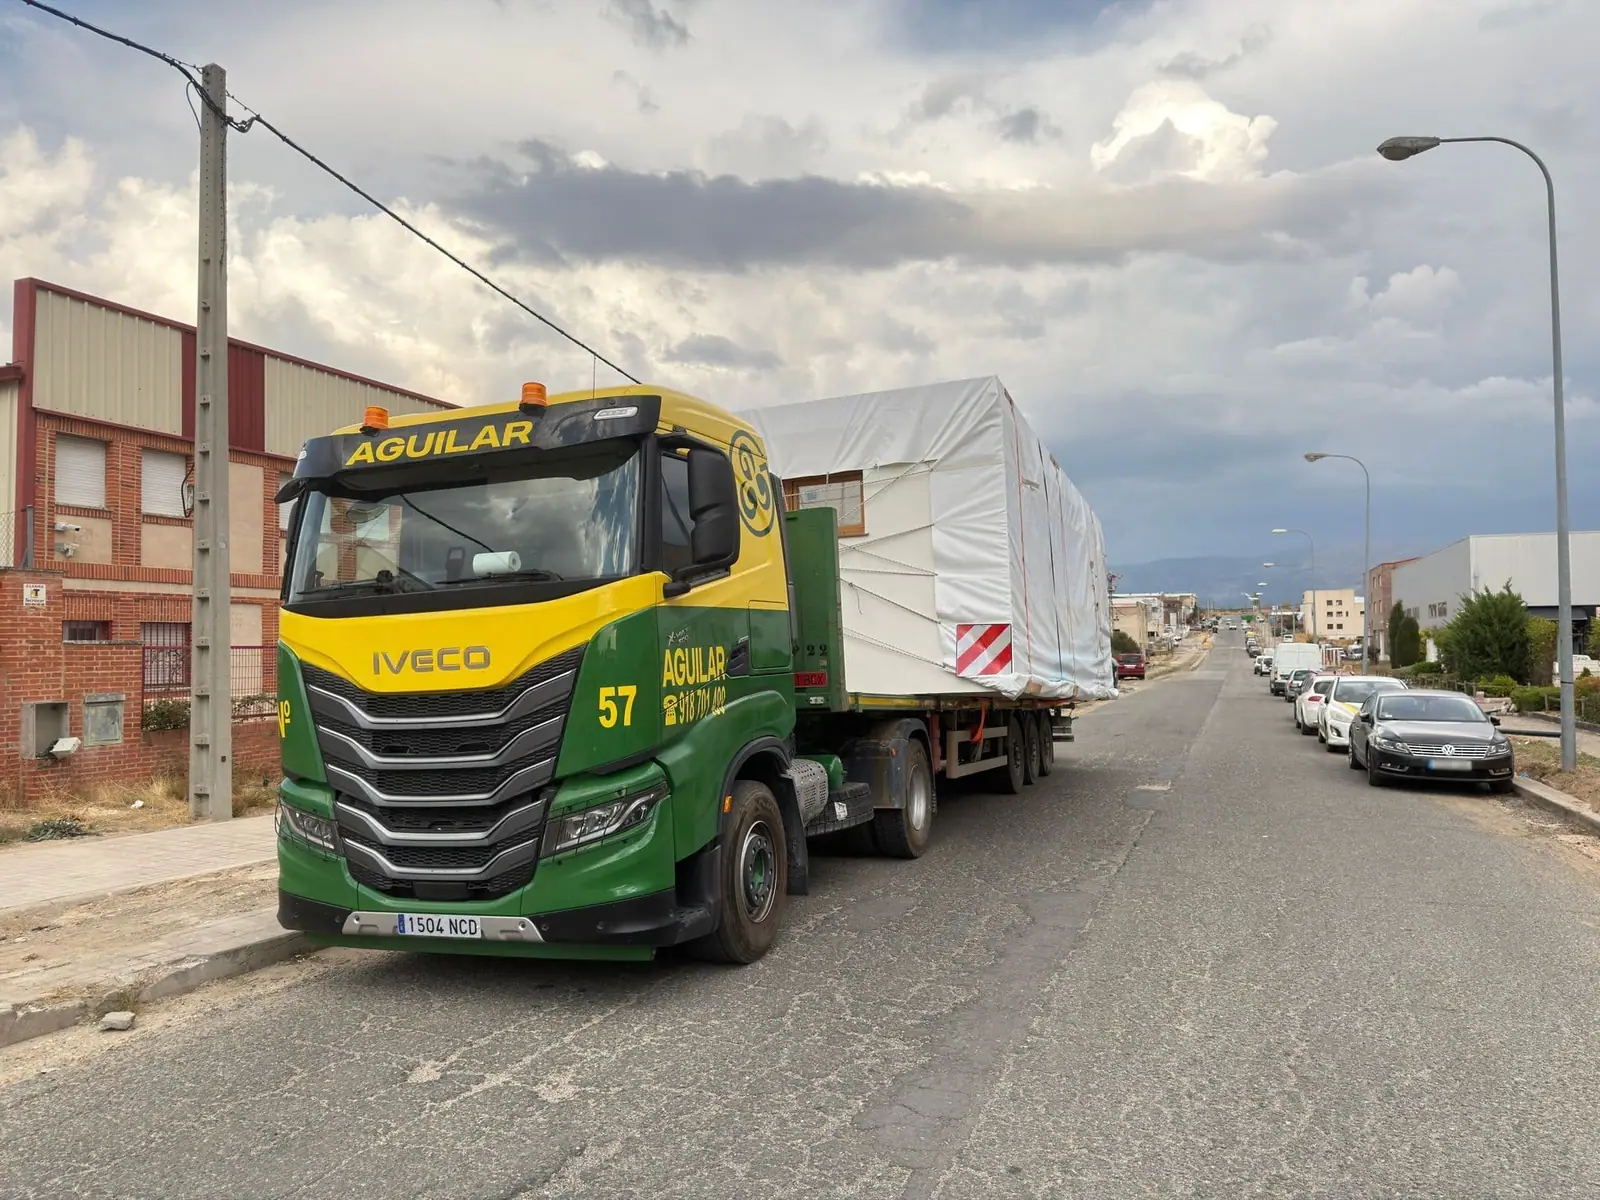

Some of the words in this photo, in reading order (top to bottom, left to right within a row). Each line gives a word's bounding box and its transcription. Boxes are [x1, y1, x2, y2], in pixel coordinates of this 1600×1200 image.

[345, 420, 534, 466] AGUILAR
[373, 645, 491, 675] IVECO
[662, 646, 725, 687] AGUILAR
[599, 685, 637, 728] 57
[679, 690, 695, 724] 918
[696, 687, 710, 720] 701
[408, 916, 444, 935] 1504
[449, 918, 478, 935] NCD
